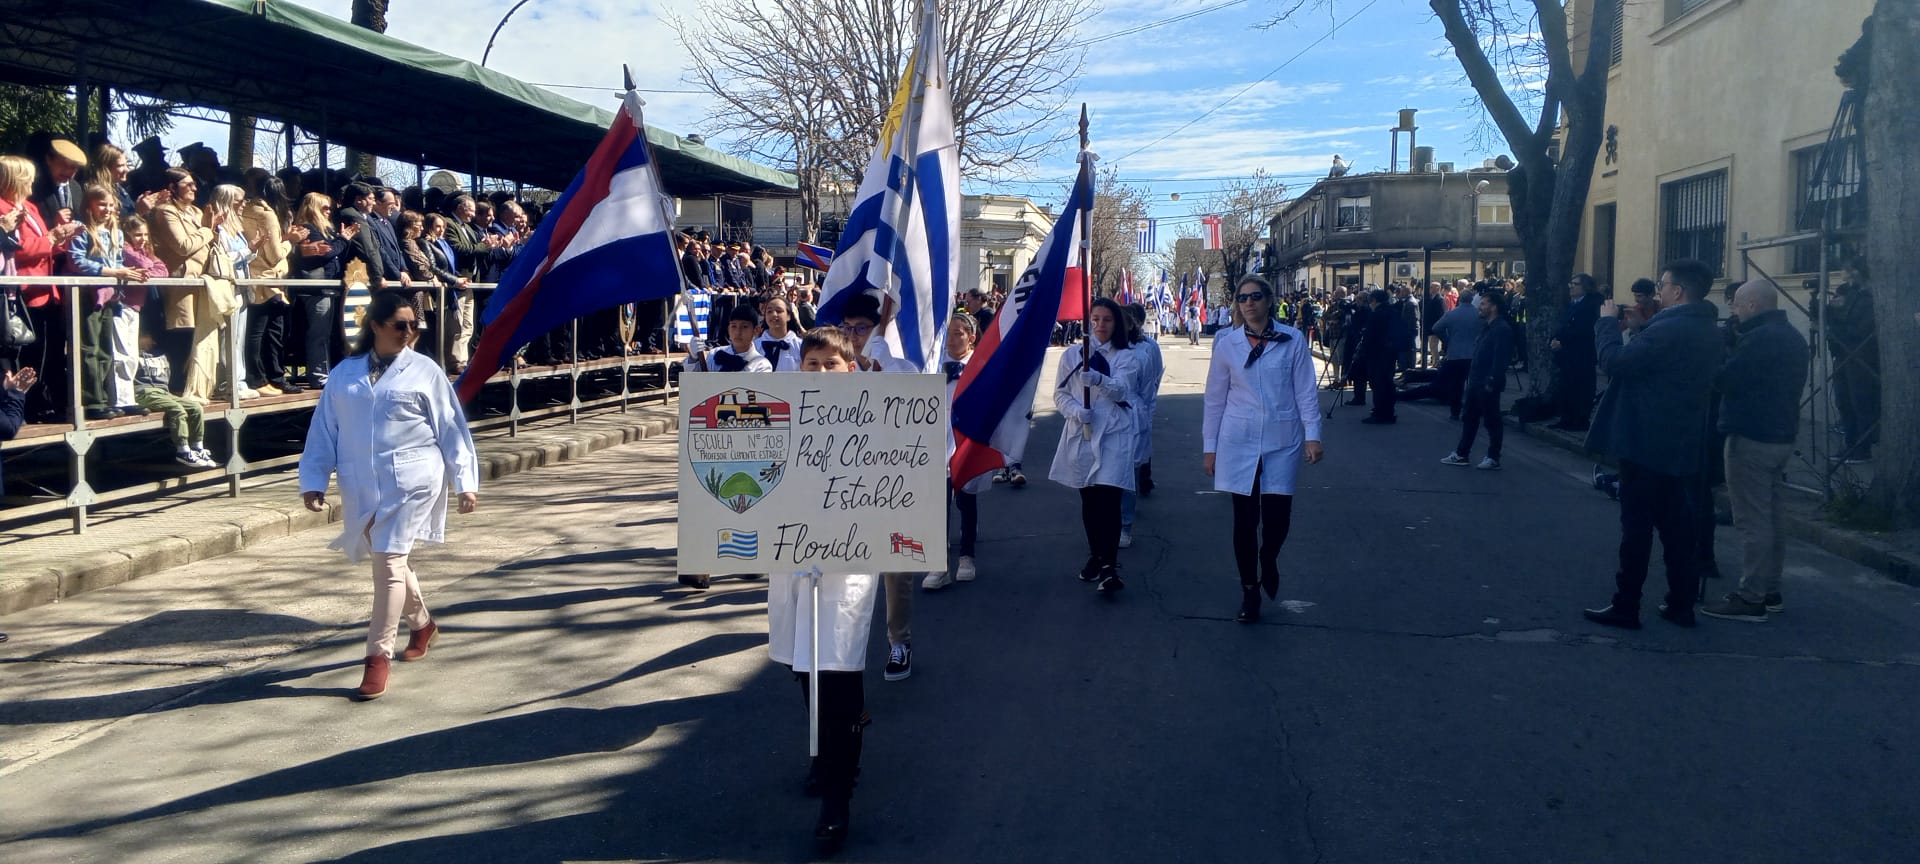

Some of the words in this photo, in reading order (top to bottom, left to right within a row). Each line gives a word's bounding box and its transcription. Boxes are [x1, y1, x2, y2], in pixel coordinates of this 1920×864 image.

[798, 389, 877, 428] Escuela
[693, 433, 733, 450] ESCUELA
[796, 433, 834, 473] Prof.
[840, 433, 930, 469] Clemente
[823, 474, 916, 511] Estable
[773, 522, 873, 565] Florida
